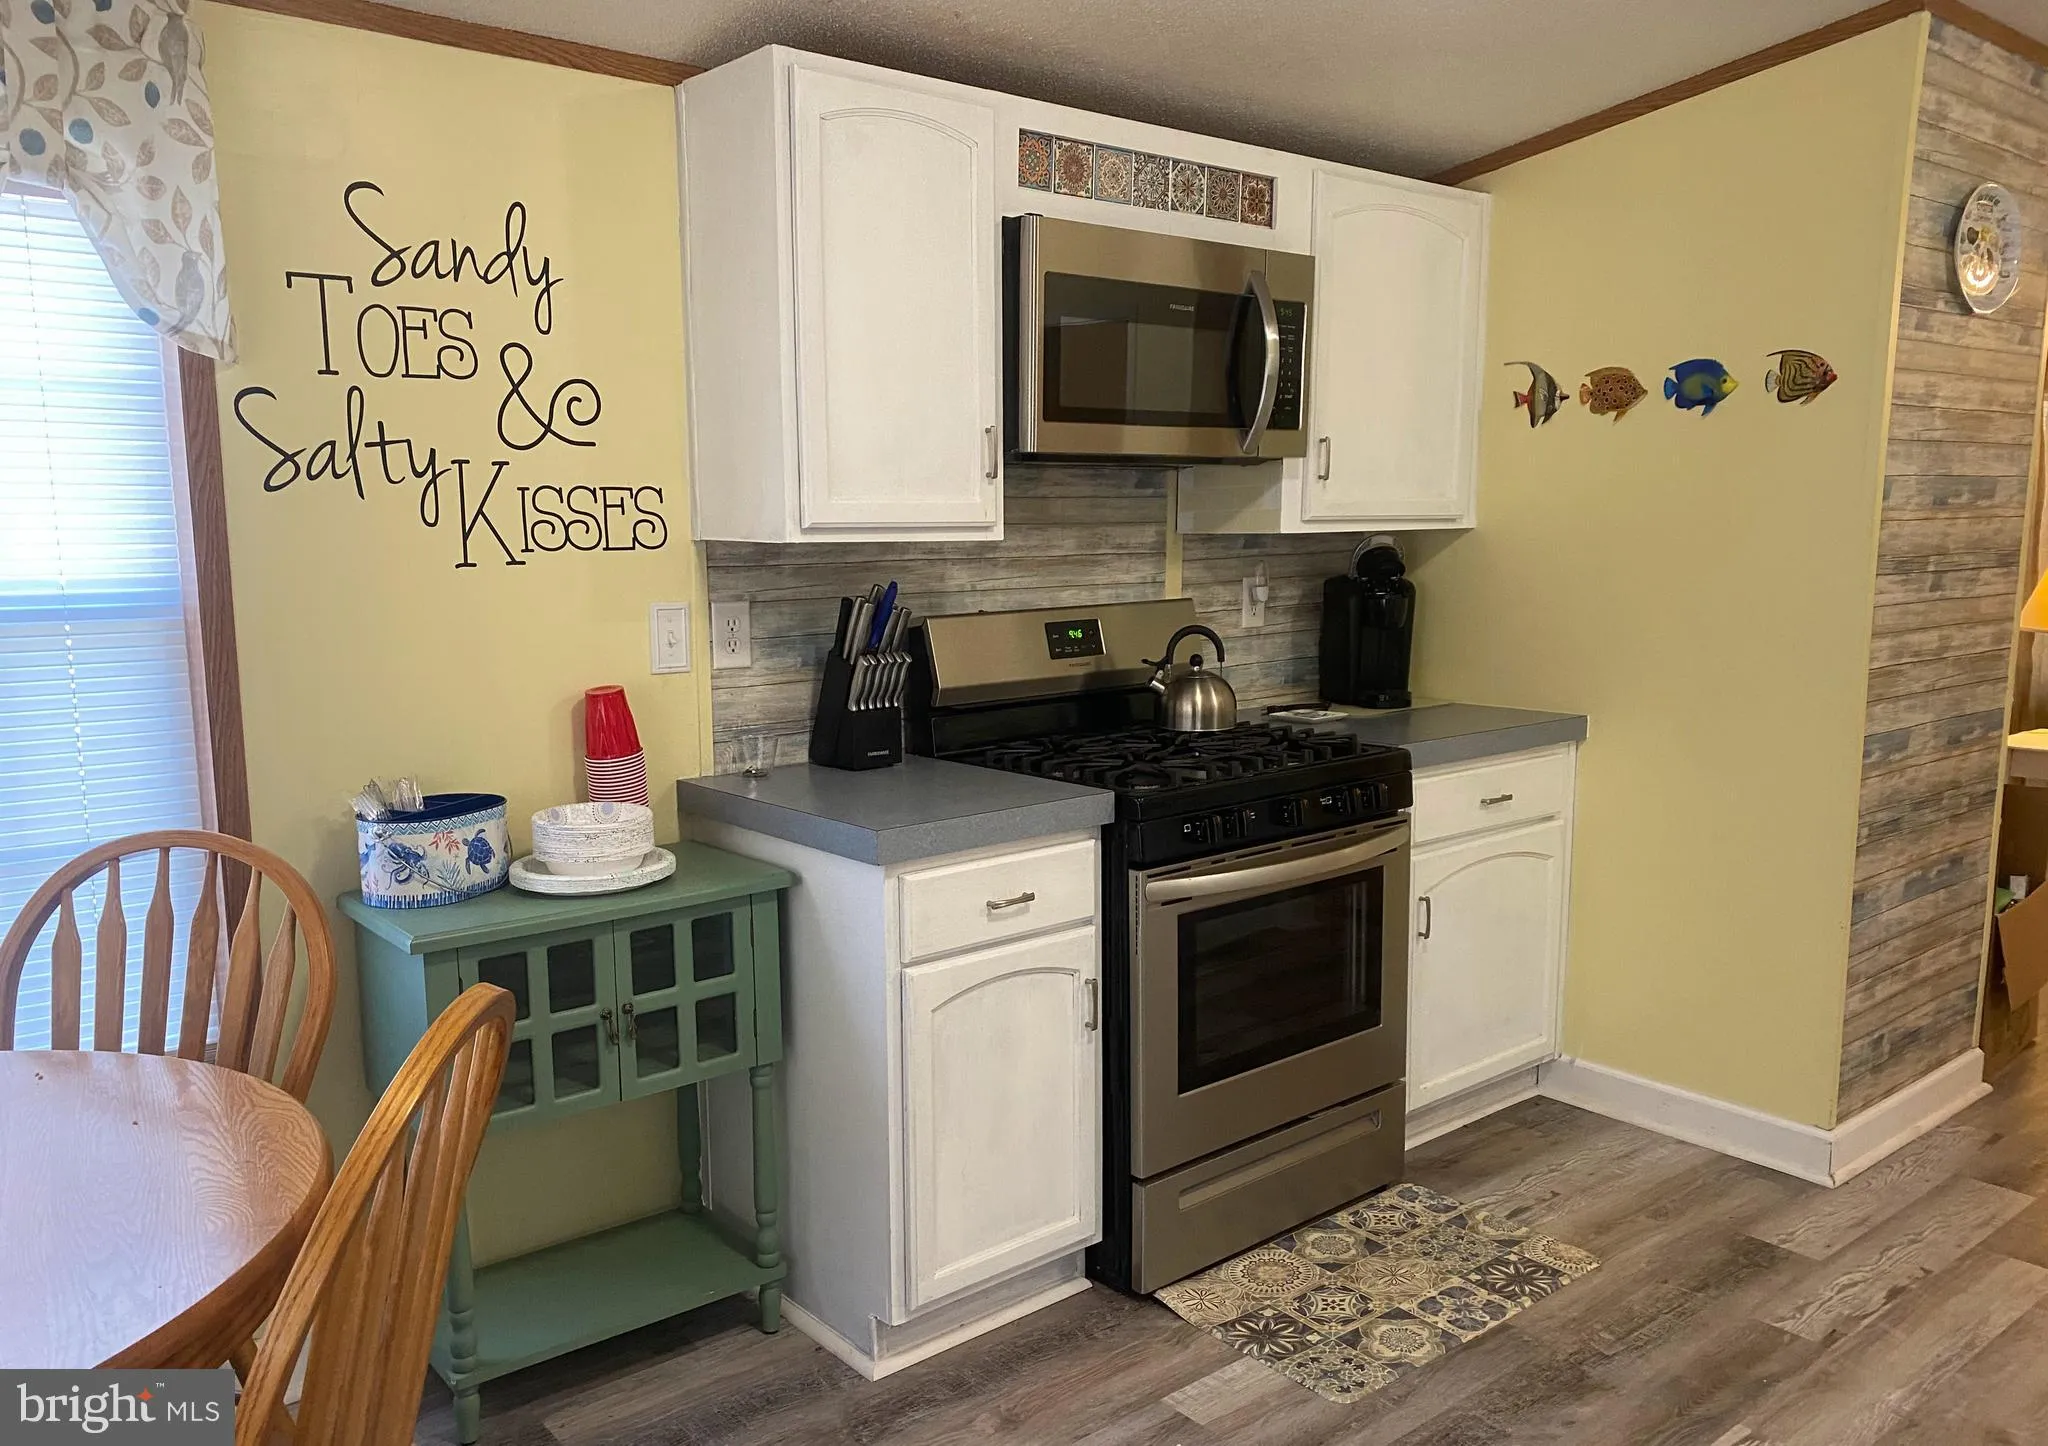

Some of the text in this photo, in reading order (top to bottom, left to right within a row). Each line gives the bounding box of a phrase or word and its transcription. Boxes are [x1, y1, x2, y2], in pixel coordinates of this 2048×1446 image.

[343, 181, 565, 336] Sandy
[285, 270, 602, 451] TOES &
[233, 385, 452, 528] Salty
[450, 459, 668, 570] KISSES
